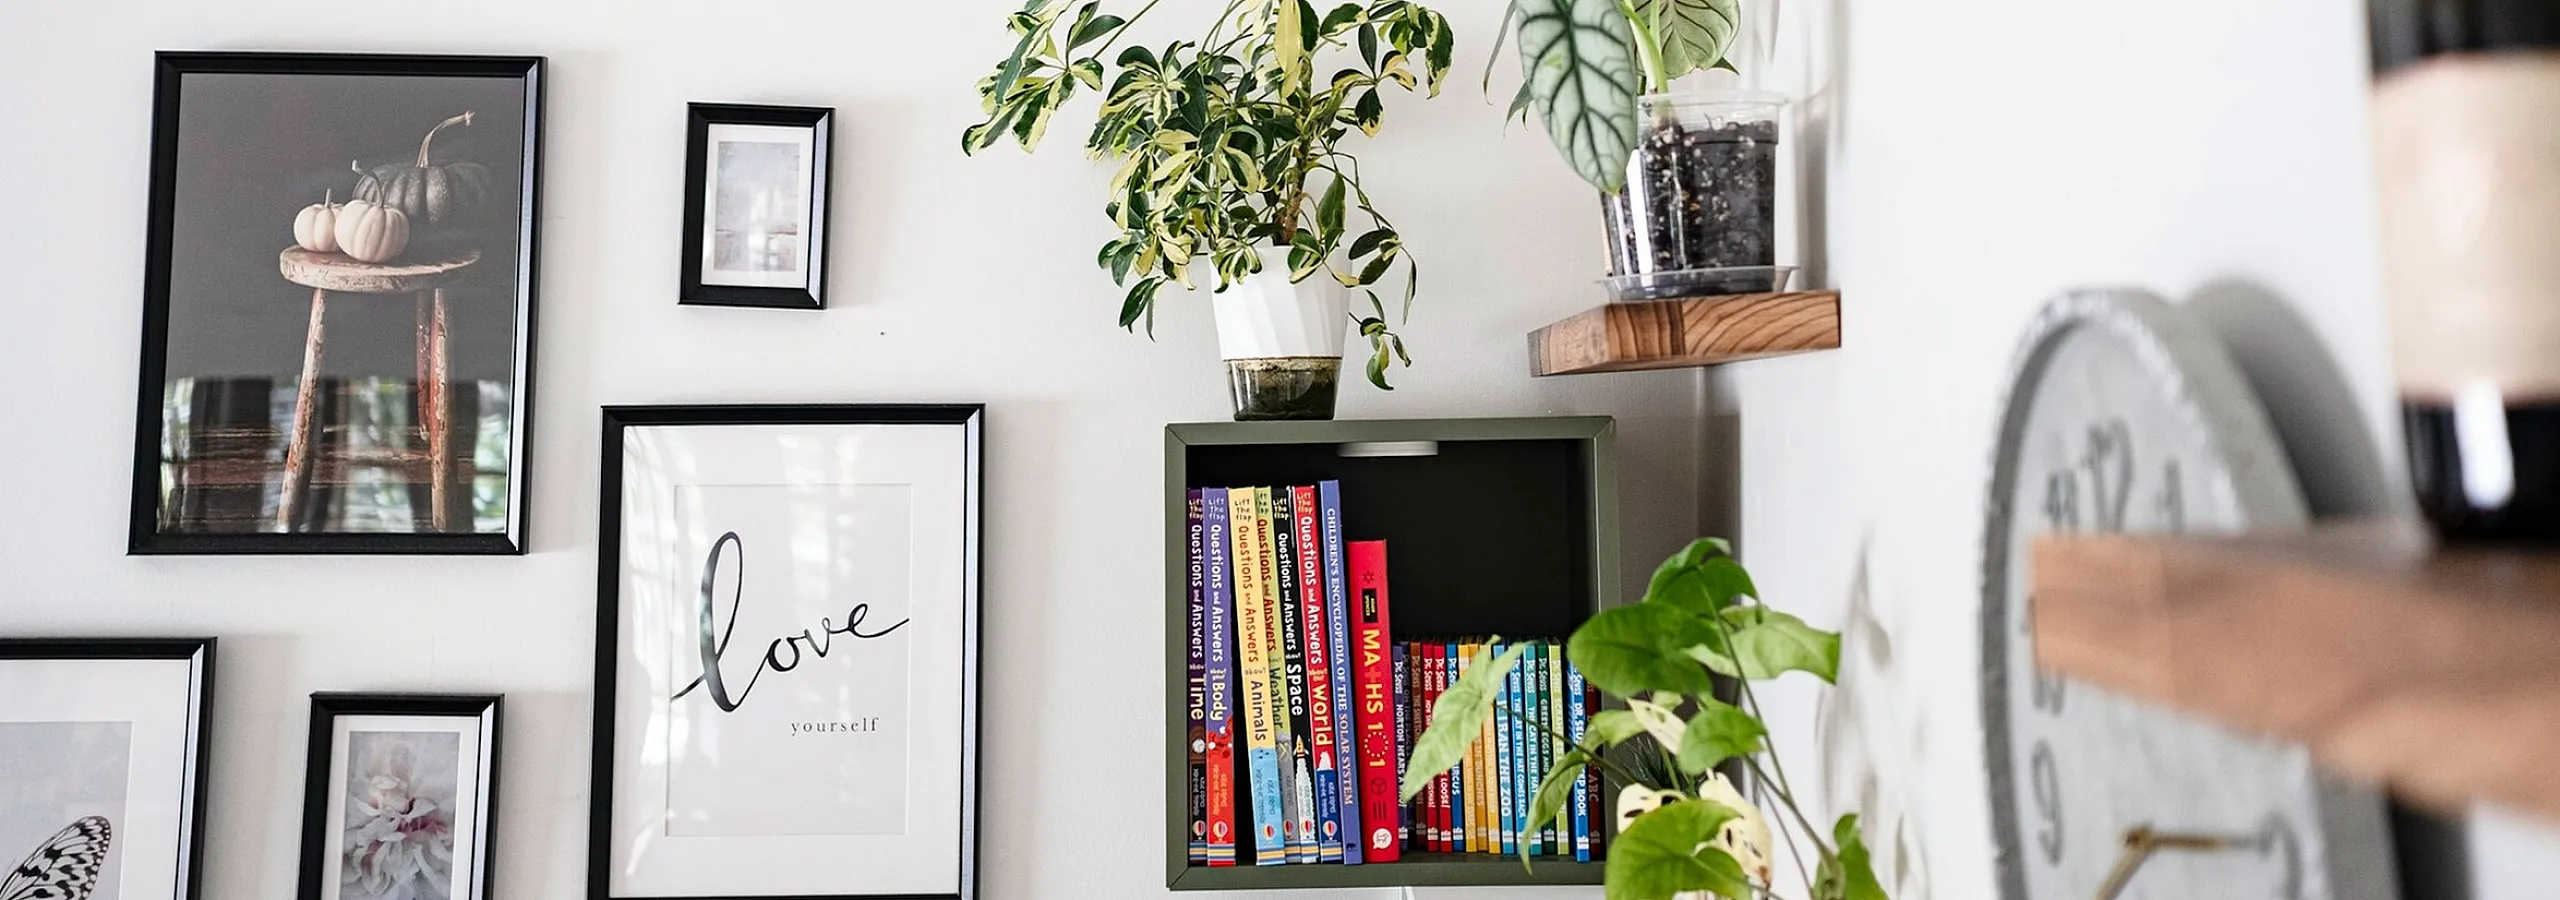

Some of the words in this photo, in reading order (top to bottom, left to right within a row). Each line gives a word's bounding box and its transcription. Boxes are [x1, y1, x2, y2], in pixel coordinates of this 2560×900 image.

[1208, 497, 1224, 505] Lift
[1190, 524, 1204, 588] Questions
[1256, 519, 1272, 582] Questions
[1300, 515, 1318, 586] Questions
[1326, 507, 1339, 576] CHILDREN'S
[1210, 524, 1224, 589] Questions
[1238, 525, 1253, 590] Questions
[1277, 532, 1292, 589] Questions
[670, 530, 910, 713] love
[1191, 604, 1204, 659] Answers
[1212, 606, 1224, 662] Answers
[1244, 608, 1259, 663] Answers
[1262, 598, 1277, 652] Answers
[1283, 602, 1297, 651] Answers
[1307, 604, 1323, 665] Answers
[1331, 577, 1345, 665] ENCYCLOPEDIA
[1336, 667, 1346, 684] OF
[1394, 660, 1404, 673] Dr.
[1411, 655, 1421, 667] Dr.
[1423, 657, 1433, 670] Dr.
[1435, 657, 1445, 670] Dr.
[1448, 657, 1457, 670] Dr.
[1526, 659, 1536, 672] Dr.
[1538, 657, 1548, 670] Dr.
[1286, 663, 1304, 716] Space
[1394, 673, 1404, 695] Seuss
[1411, 667, 1421, 689] Seuss
[1423, 670, 1433, 692] Seuss
[1435, 670, 1445, 692] Seuss
[1511, 671, 1522, 693] Seuss
[1526, 672, 1536, 693] Seuss
[1538, 670, 1548, 692] Seuss
[1573, 673, 1584, 696] Seuss
[1190, 673, 1207, 720] Time
[1209, 682, 1228, 721] Body
[1250, 680, 1268, 741] Animals
[1269, 667, 1285, 729] Weather
[1337, 684, 1348, 710] THE
[1413, 694, 1421, 708] THE
[1574, 701, 1584, 719] DR.
[790, 716, 881, 738] yourself
[1311, 683, 1333, 746] World
[1395, 703, 1405, 742] HORTON
[1339, 713, 1351, 754] SOLAR
[1498, 723, 1510, 754] RAN
[1515, 730, 1523, 740] IN
[1528, 724, 1538, 742] CAT
[1541, 731, 1550, 755] EGGS
[1396, 744, 1406, 776] HEARS
[1516, 741, 1524, 757] THE
[1529, 743, 1538, 755] IN
[1498, 755, 1511, 784] THE
[1516, 757, 1525, 773] HAT
[1530, 756, 1539, 774] THE
[1542, 755, 1550, 773] AND
[1341, 756, 1354, 806] SYSTEM
[1440, 777, 1451, 809] LOOSE!
[1451, 763, 1461, 796] IRCUS
[1475, 760, 1485, 807] BUNCHES
[1516, 774, 1526, 798] COMES
[1531, 775, 1540, 794] HAT
[1588, 773, 1599, 803] ABC
[1500, 786, 1512, 817] ZOO
[1517, 798, 1527, 819] BACK
[1576, 788, 1587, 817] BOOK
